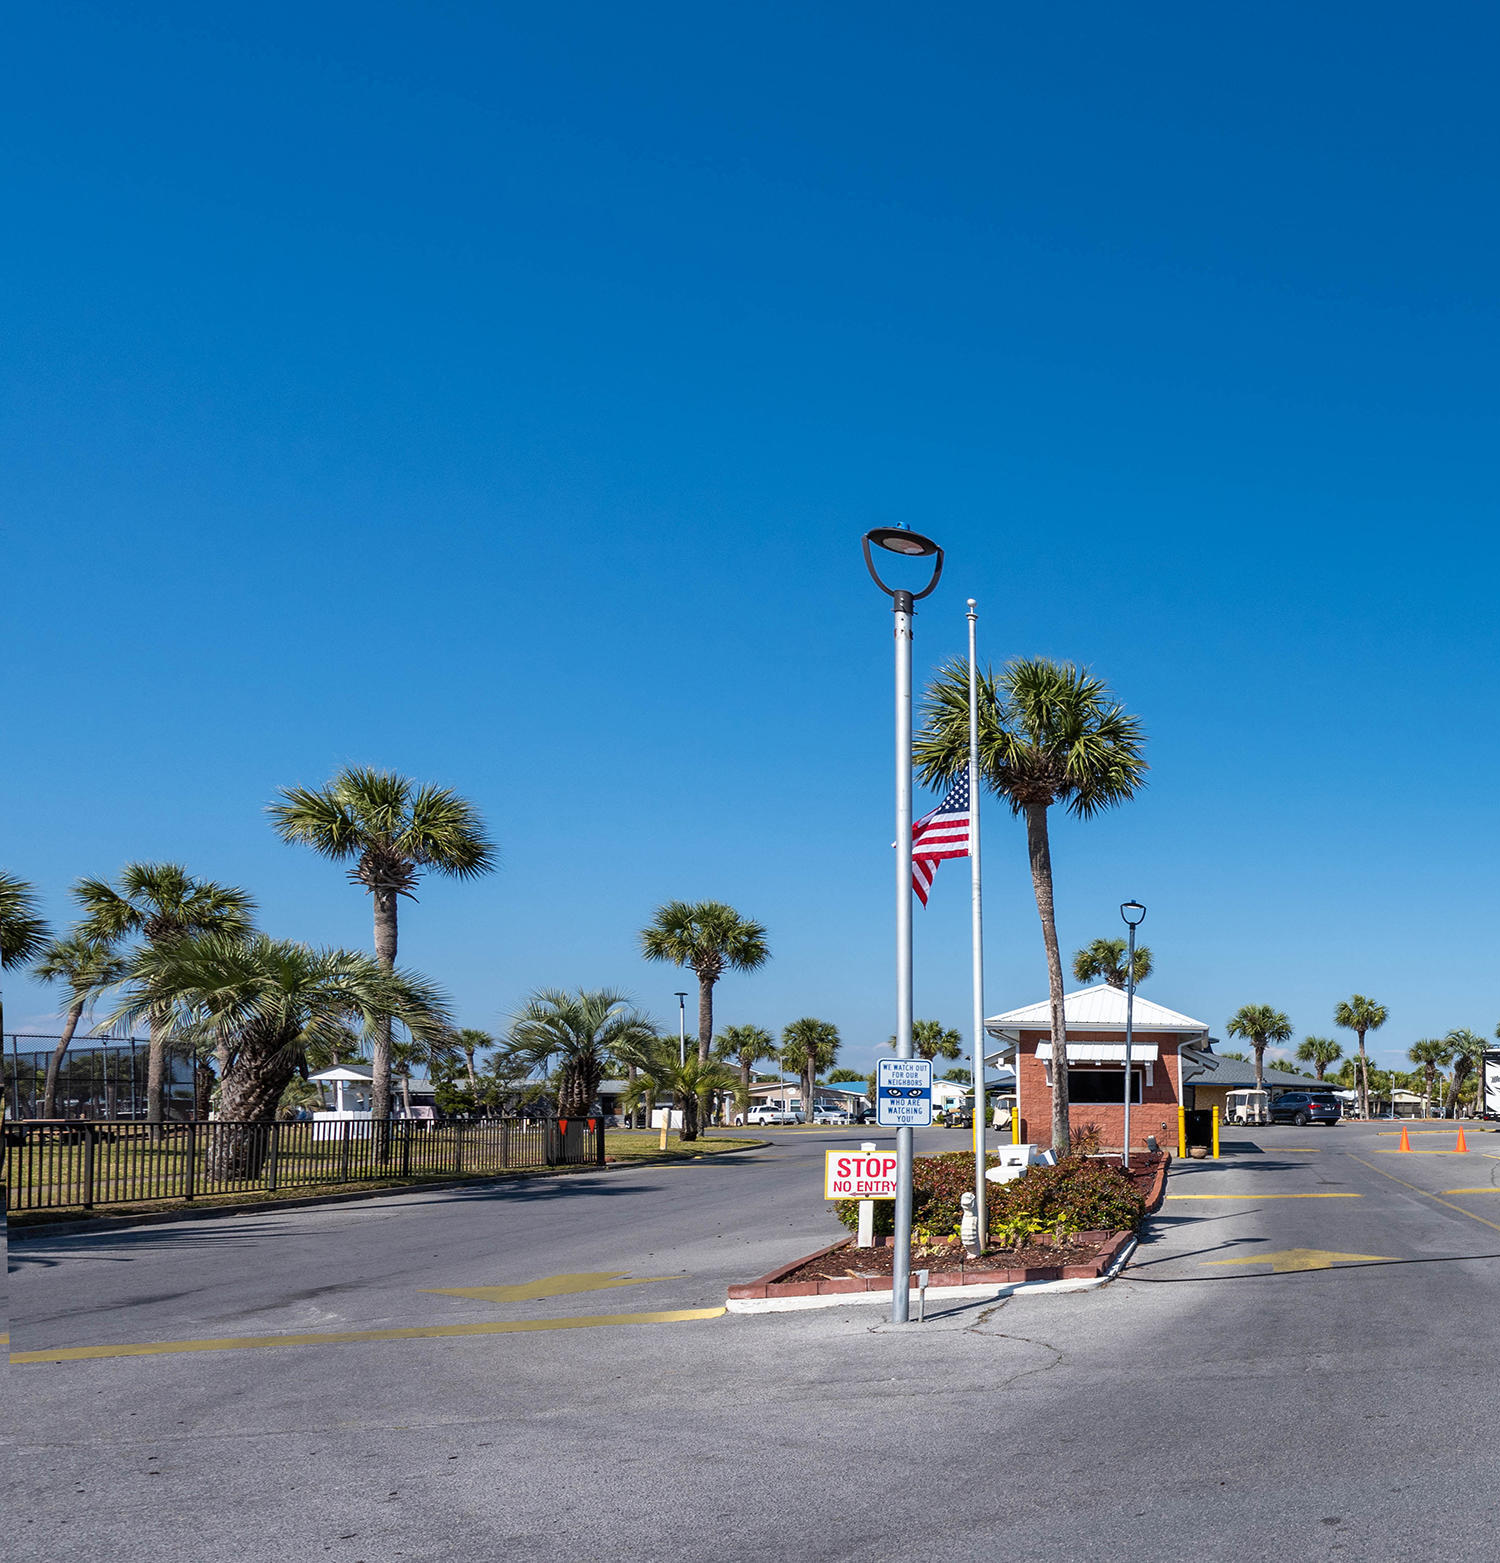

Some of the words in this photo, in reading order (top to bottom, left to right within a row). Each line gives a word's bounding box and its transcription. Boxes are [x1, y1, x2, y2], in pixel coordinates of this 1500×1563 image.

[837, 1158, 897, 1178] STOP
[833, 1181, 852, 1192] NO
[856, 1181, 896, 1192] ENTRY
